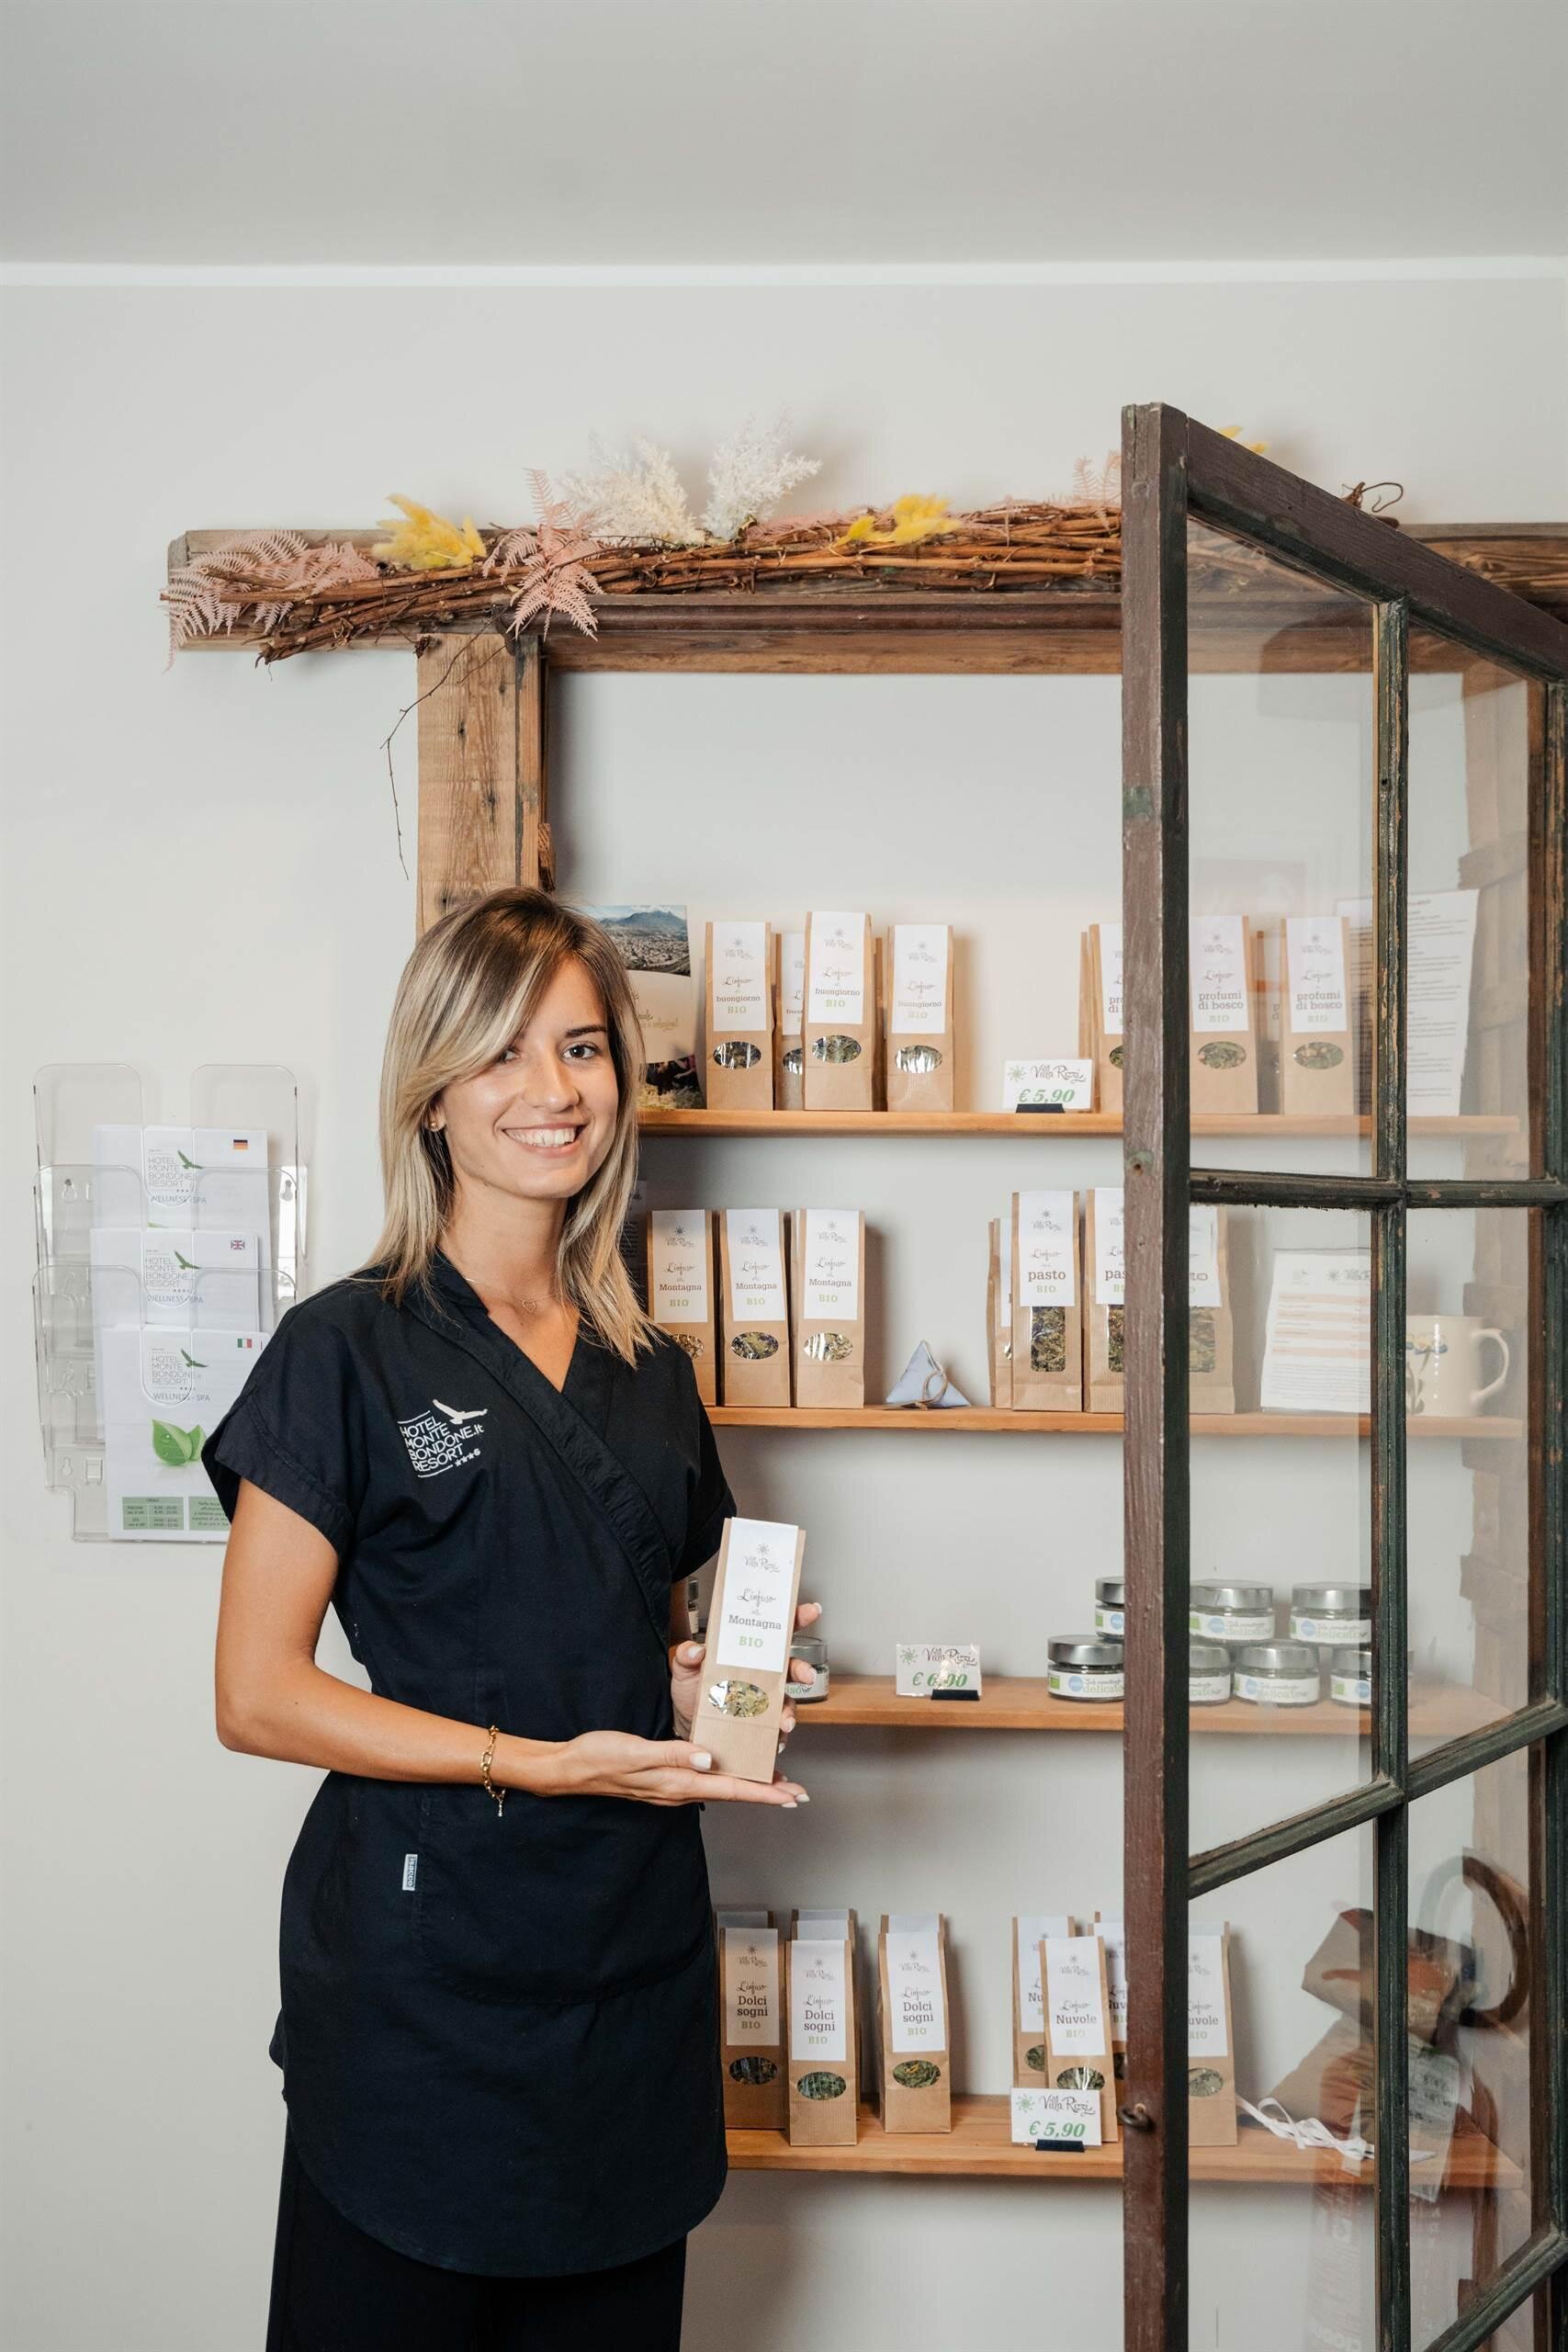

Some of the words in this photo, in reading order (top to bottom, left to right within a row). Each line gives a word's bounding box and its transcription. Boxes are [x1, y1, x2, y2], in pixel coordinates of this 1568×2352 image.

[815, 987, 861, 997] buongiorno
[1198, 990, 1242, 1002] profumi
[1296, 990, 1341, 1002] profumi
[716, 995, 761, 1003] buongiorno
[826, 999, 846, 1008] BIO
[897, 999, 942, 1009] buongiorno
[728, 1005, 748, 1014] BIO
[1198, 1000, 1209, 1010] di
[1212, 1000, 1244, 1011] bosco
[1295, 1000, 1307, 1011] di
[1310, 1000, 1343, 1011] bosco
[1209, 1014, 1230, 1023] BIO
[1030, 1063, 1055, 1080] Villa
[1019, 1088, 1031, 1103] €
[1027, 1270, 1066, 1283] pasto
[1104, 1270, 1125, 1282] pas
[659, 1283, 703, 1293] Montagna
[735, 1282, 778, 1291] Montagna
[808, 1278, 852, 1288] Montagna
[1036, 1284, 1056, 1294] BIO
[670, 1299, 689, 1307] BIO
[746, 1297, 765, 1306] BIO
[818, 1294, 838, 1303] BIO
[196, 1394, 211, 1402] SPA
[399, 1415, 442, 1439] HOTEL
[404, 1421, 451, 1450] MONTE
[412, 1442, 464, 1473] RESORT
[728, 1613, 783, 1631] Montagna
[739, 1635, 764, 1648] BIO
[911, 1671, 924, 1687] €
[738, 1995, 768, 2007] Dolci
[903, 2000, 932, 2012] Dolci
[737, 2007, 769, 2018] sogni
[804, 2009, 835, 2021] Dolci
[902, 2012, 934, 2025] sogni
[1055, 2014, 1098, 2025] Nuvole
[1189, 2014, 1219, 2026] uvole
[741, 2020, 761, 2030] BIO
[804, 2020, 836, 2032] sogni
[908, 2027, 927, 2036] BIO
[1066, 2030, 1086, 2039] BIO
[807, 2035, 828, 2044] BIO
[1038, 2094, 1065, 2111] Villa
[1029, 2120, 1041, 2136] €
